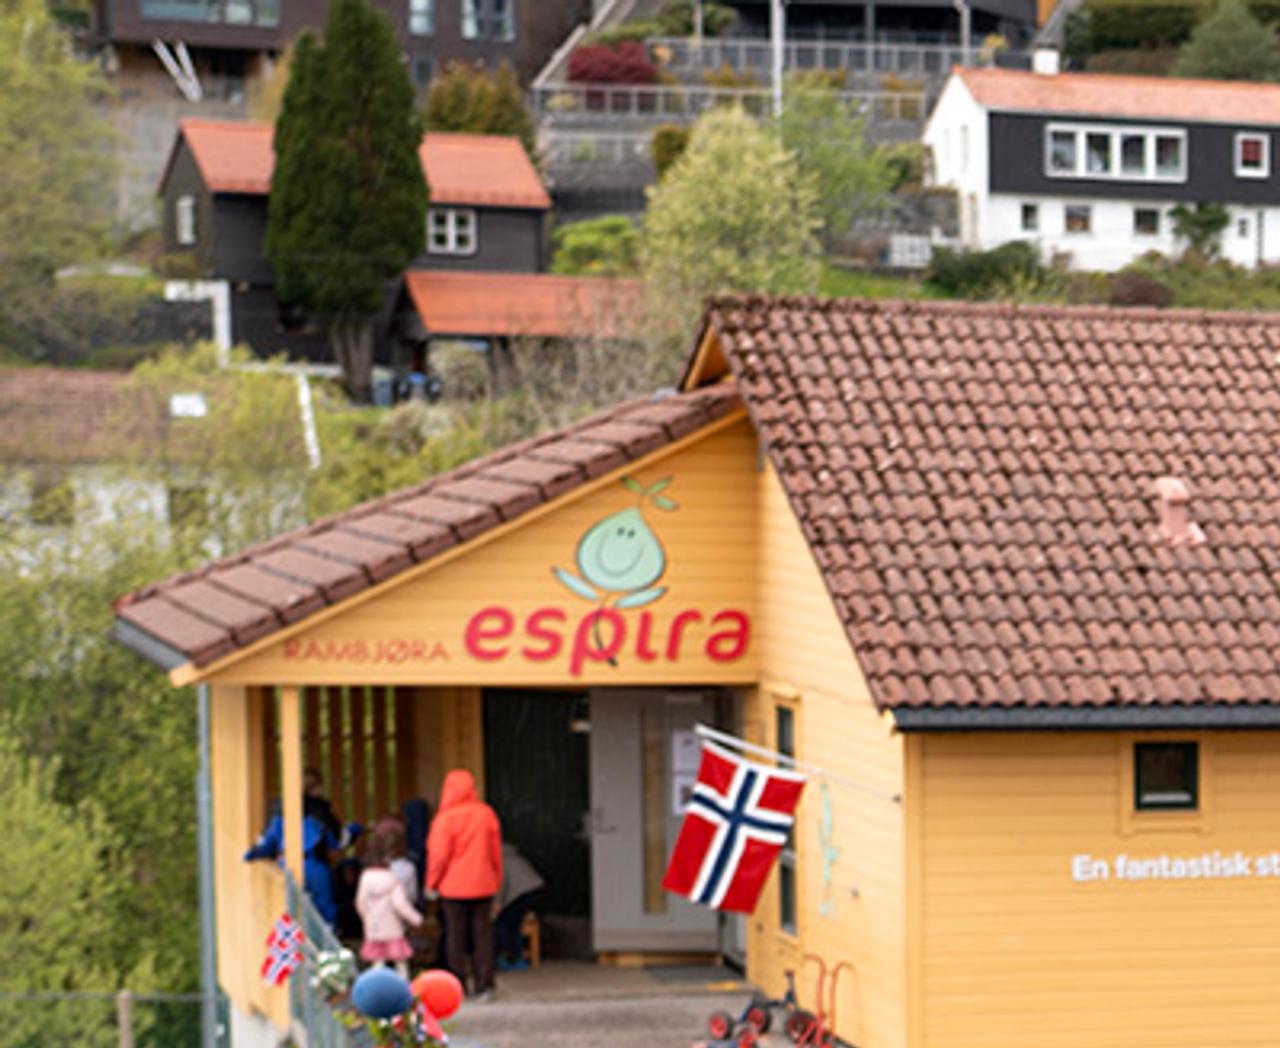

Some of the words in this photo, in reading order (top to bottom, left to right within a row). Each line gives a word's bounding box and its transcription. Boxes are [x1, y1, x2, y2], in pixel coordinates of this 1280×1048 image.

[464, 606, 751, 677] espira
[1073, 853, 1109, 880] En
[1115, 850, 1252, 879] fantastisk
